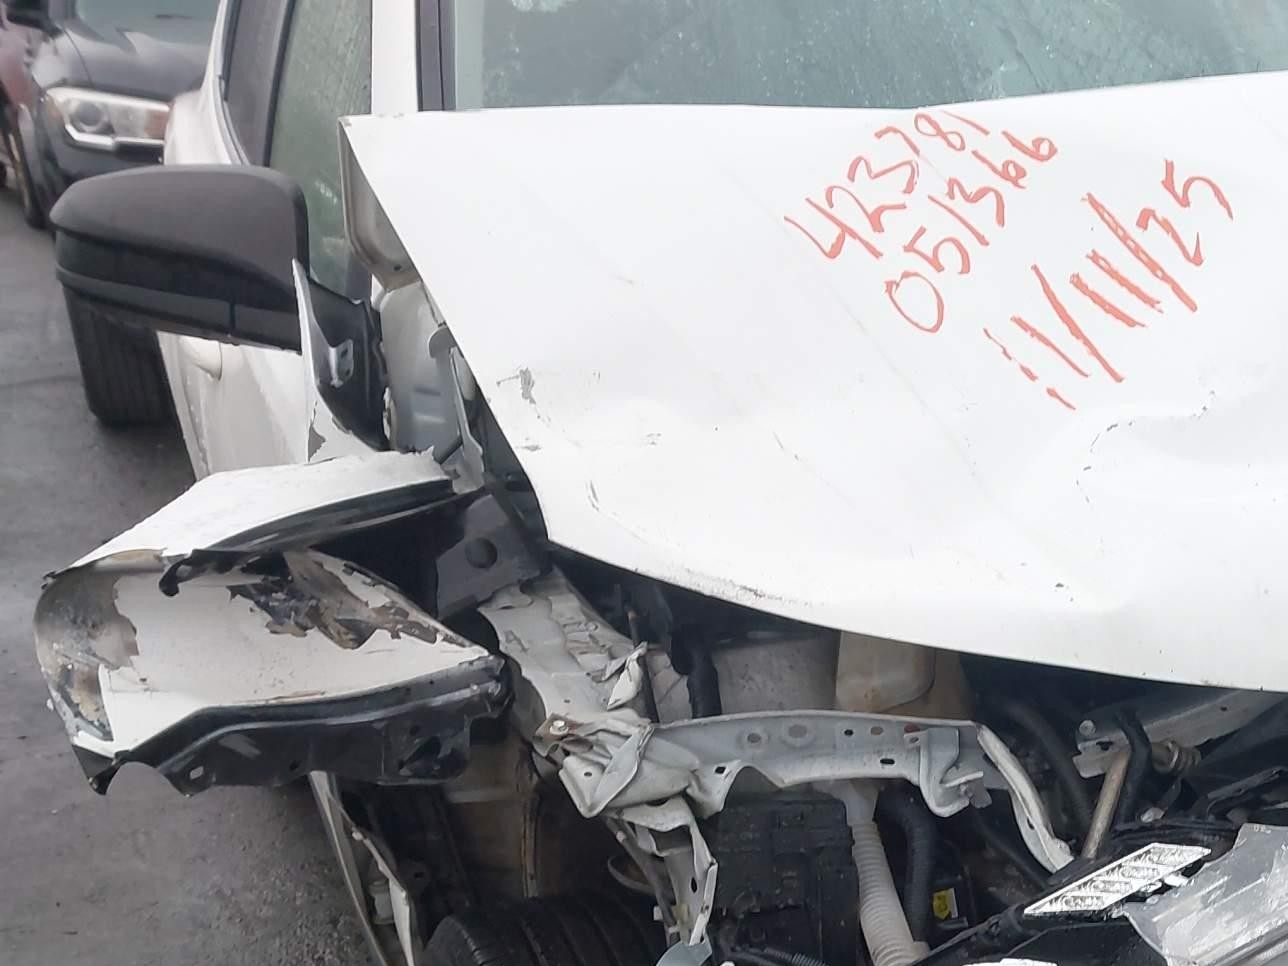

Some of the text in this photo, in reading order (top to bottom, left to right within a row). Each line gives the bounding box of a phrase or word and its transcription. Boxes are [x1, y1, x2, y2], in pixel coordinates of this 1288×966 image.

[784, 110, 989, 261] 423781
[884, 130, 1058, 335] 051366
[983, 159, 1233, 411] 11/11/25
